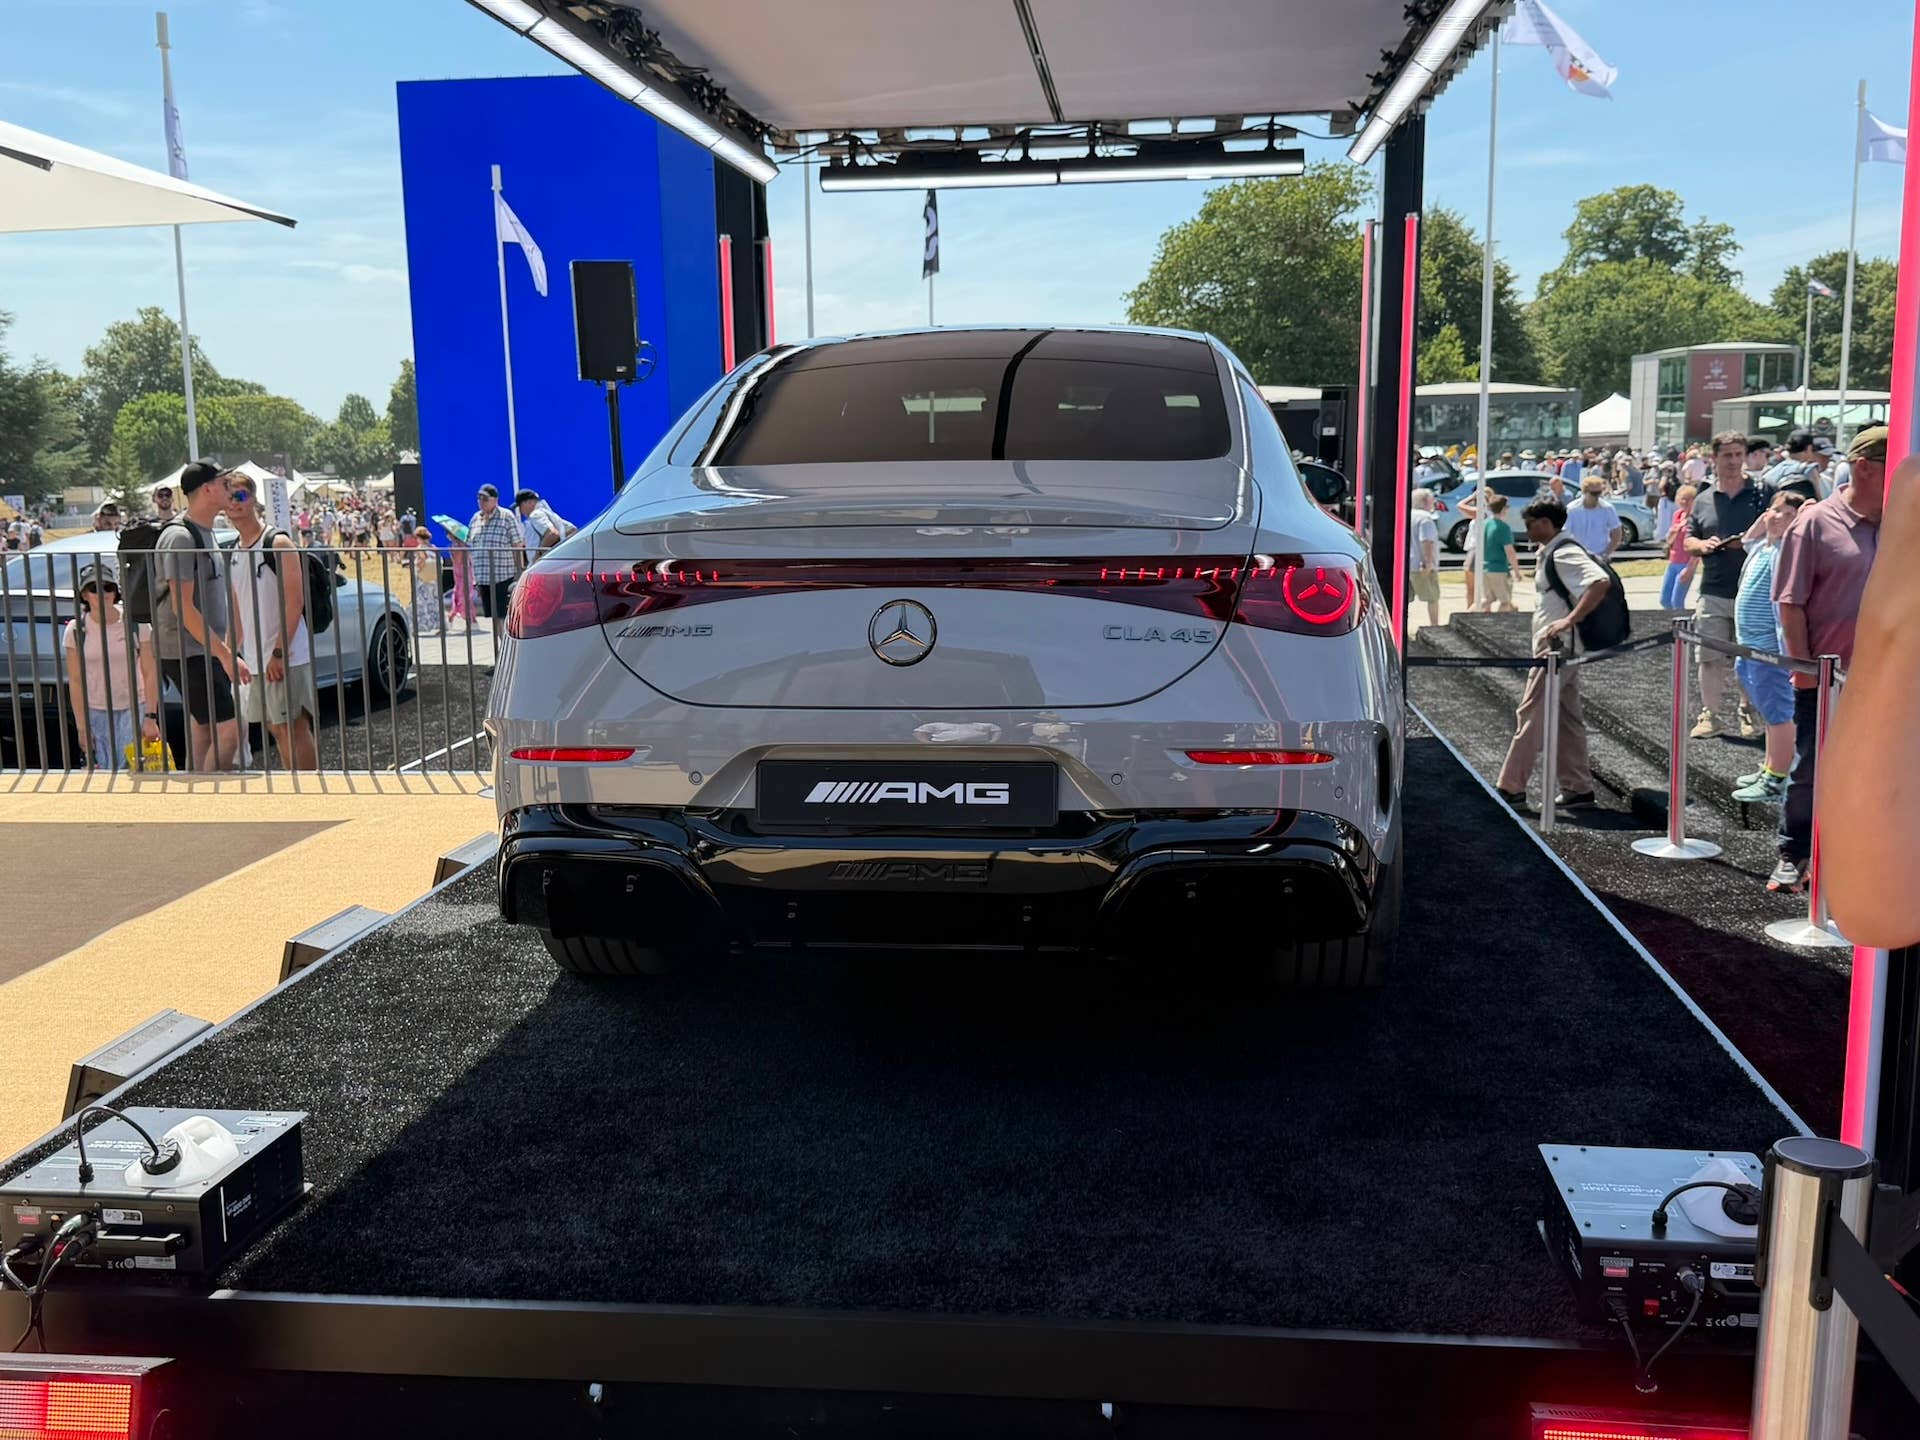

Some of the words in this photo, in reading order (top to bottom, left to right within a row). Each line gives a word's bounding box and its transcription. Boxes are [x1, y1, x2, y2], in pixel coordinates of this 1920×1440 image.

[646, 624, 714, 638] AMG
[1103, 625, 1167, 642] CLA
[1170, 629, 1213, 643] 45
[868, 782, 1010, 805] AMG
[878, 863, 989, 882] AMG
